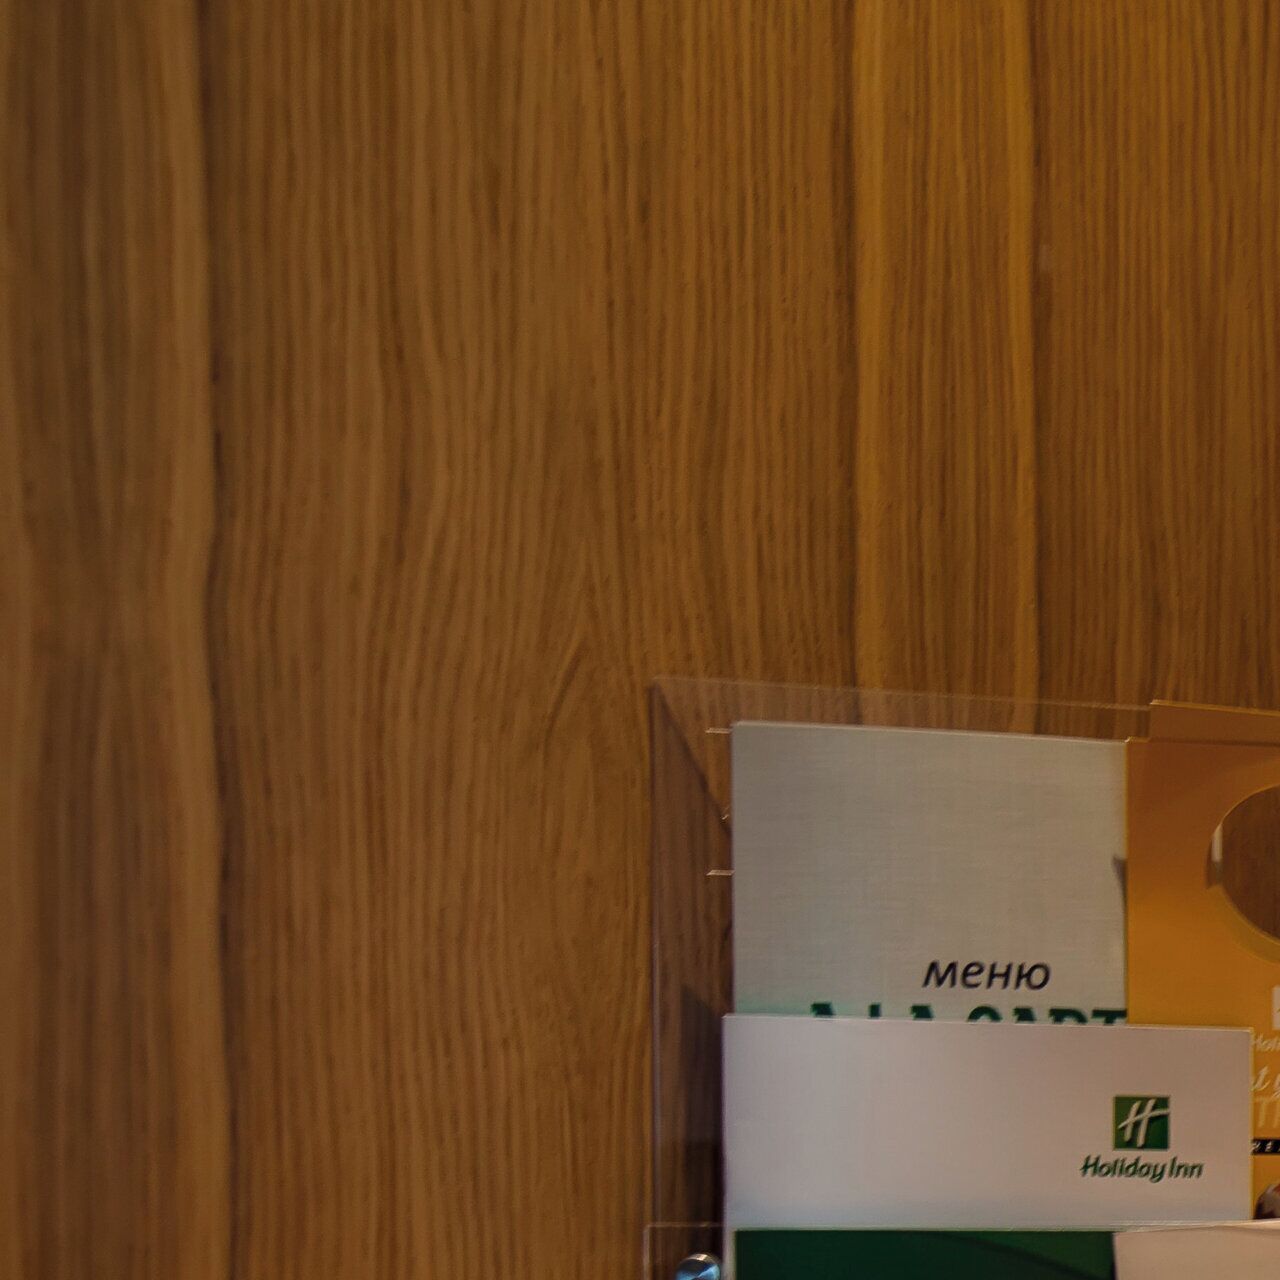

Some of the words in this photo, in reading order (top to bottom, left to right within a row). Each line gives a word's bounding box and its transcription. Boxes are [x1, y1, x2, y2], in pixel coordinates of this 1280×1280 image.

[922, 960, 1051, 991] меню
[1080, 1154, 1167, 1183] Holiday
[1168, 1156, 1204, 1179] Inn
